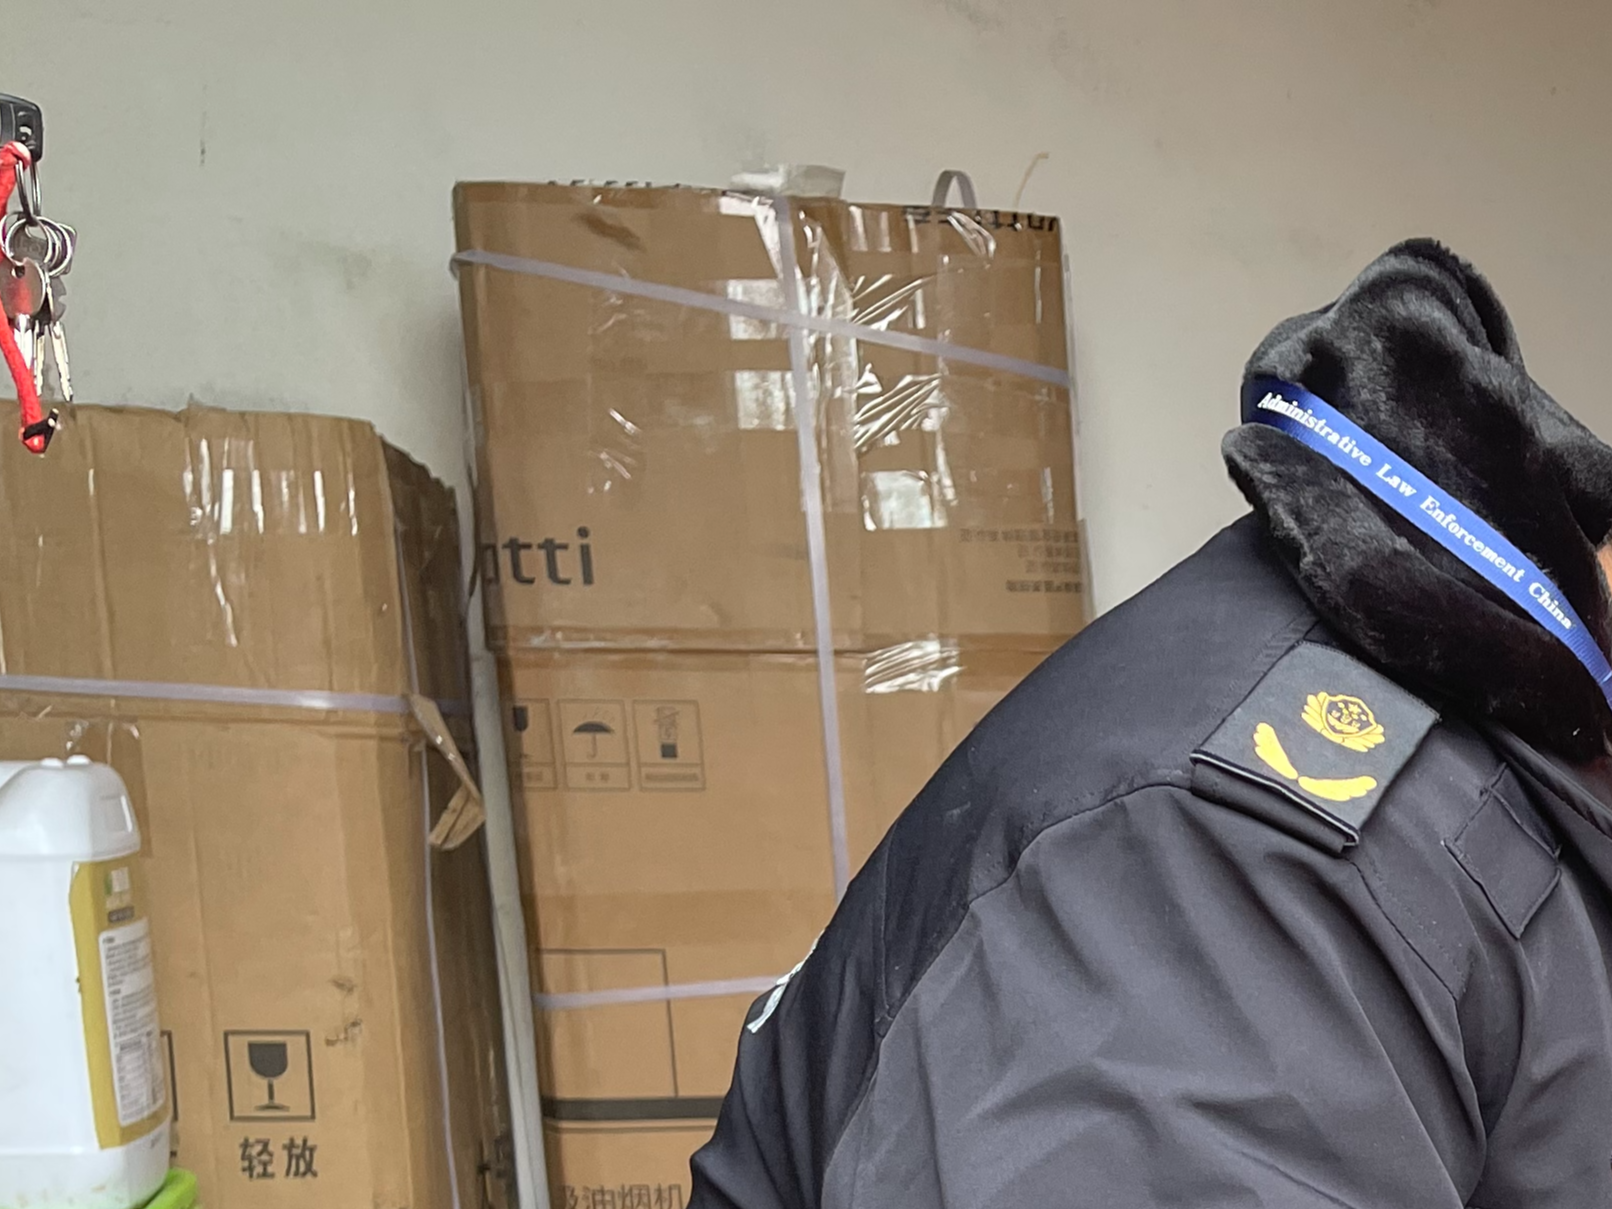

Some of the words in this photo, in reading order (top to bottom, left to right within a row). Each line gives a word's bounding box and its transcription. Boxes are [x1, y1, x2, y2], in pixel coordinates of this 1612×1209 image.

[1257, 392, 1373, 466] Administrative
[1376, 463, 1418, 498] Law
[1420, 495, 1526, 584] Enforcement
[1528, 581, 1574, 630] China
[239, 1136, 319, 1180] 轻放
